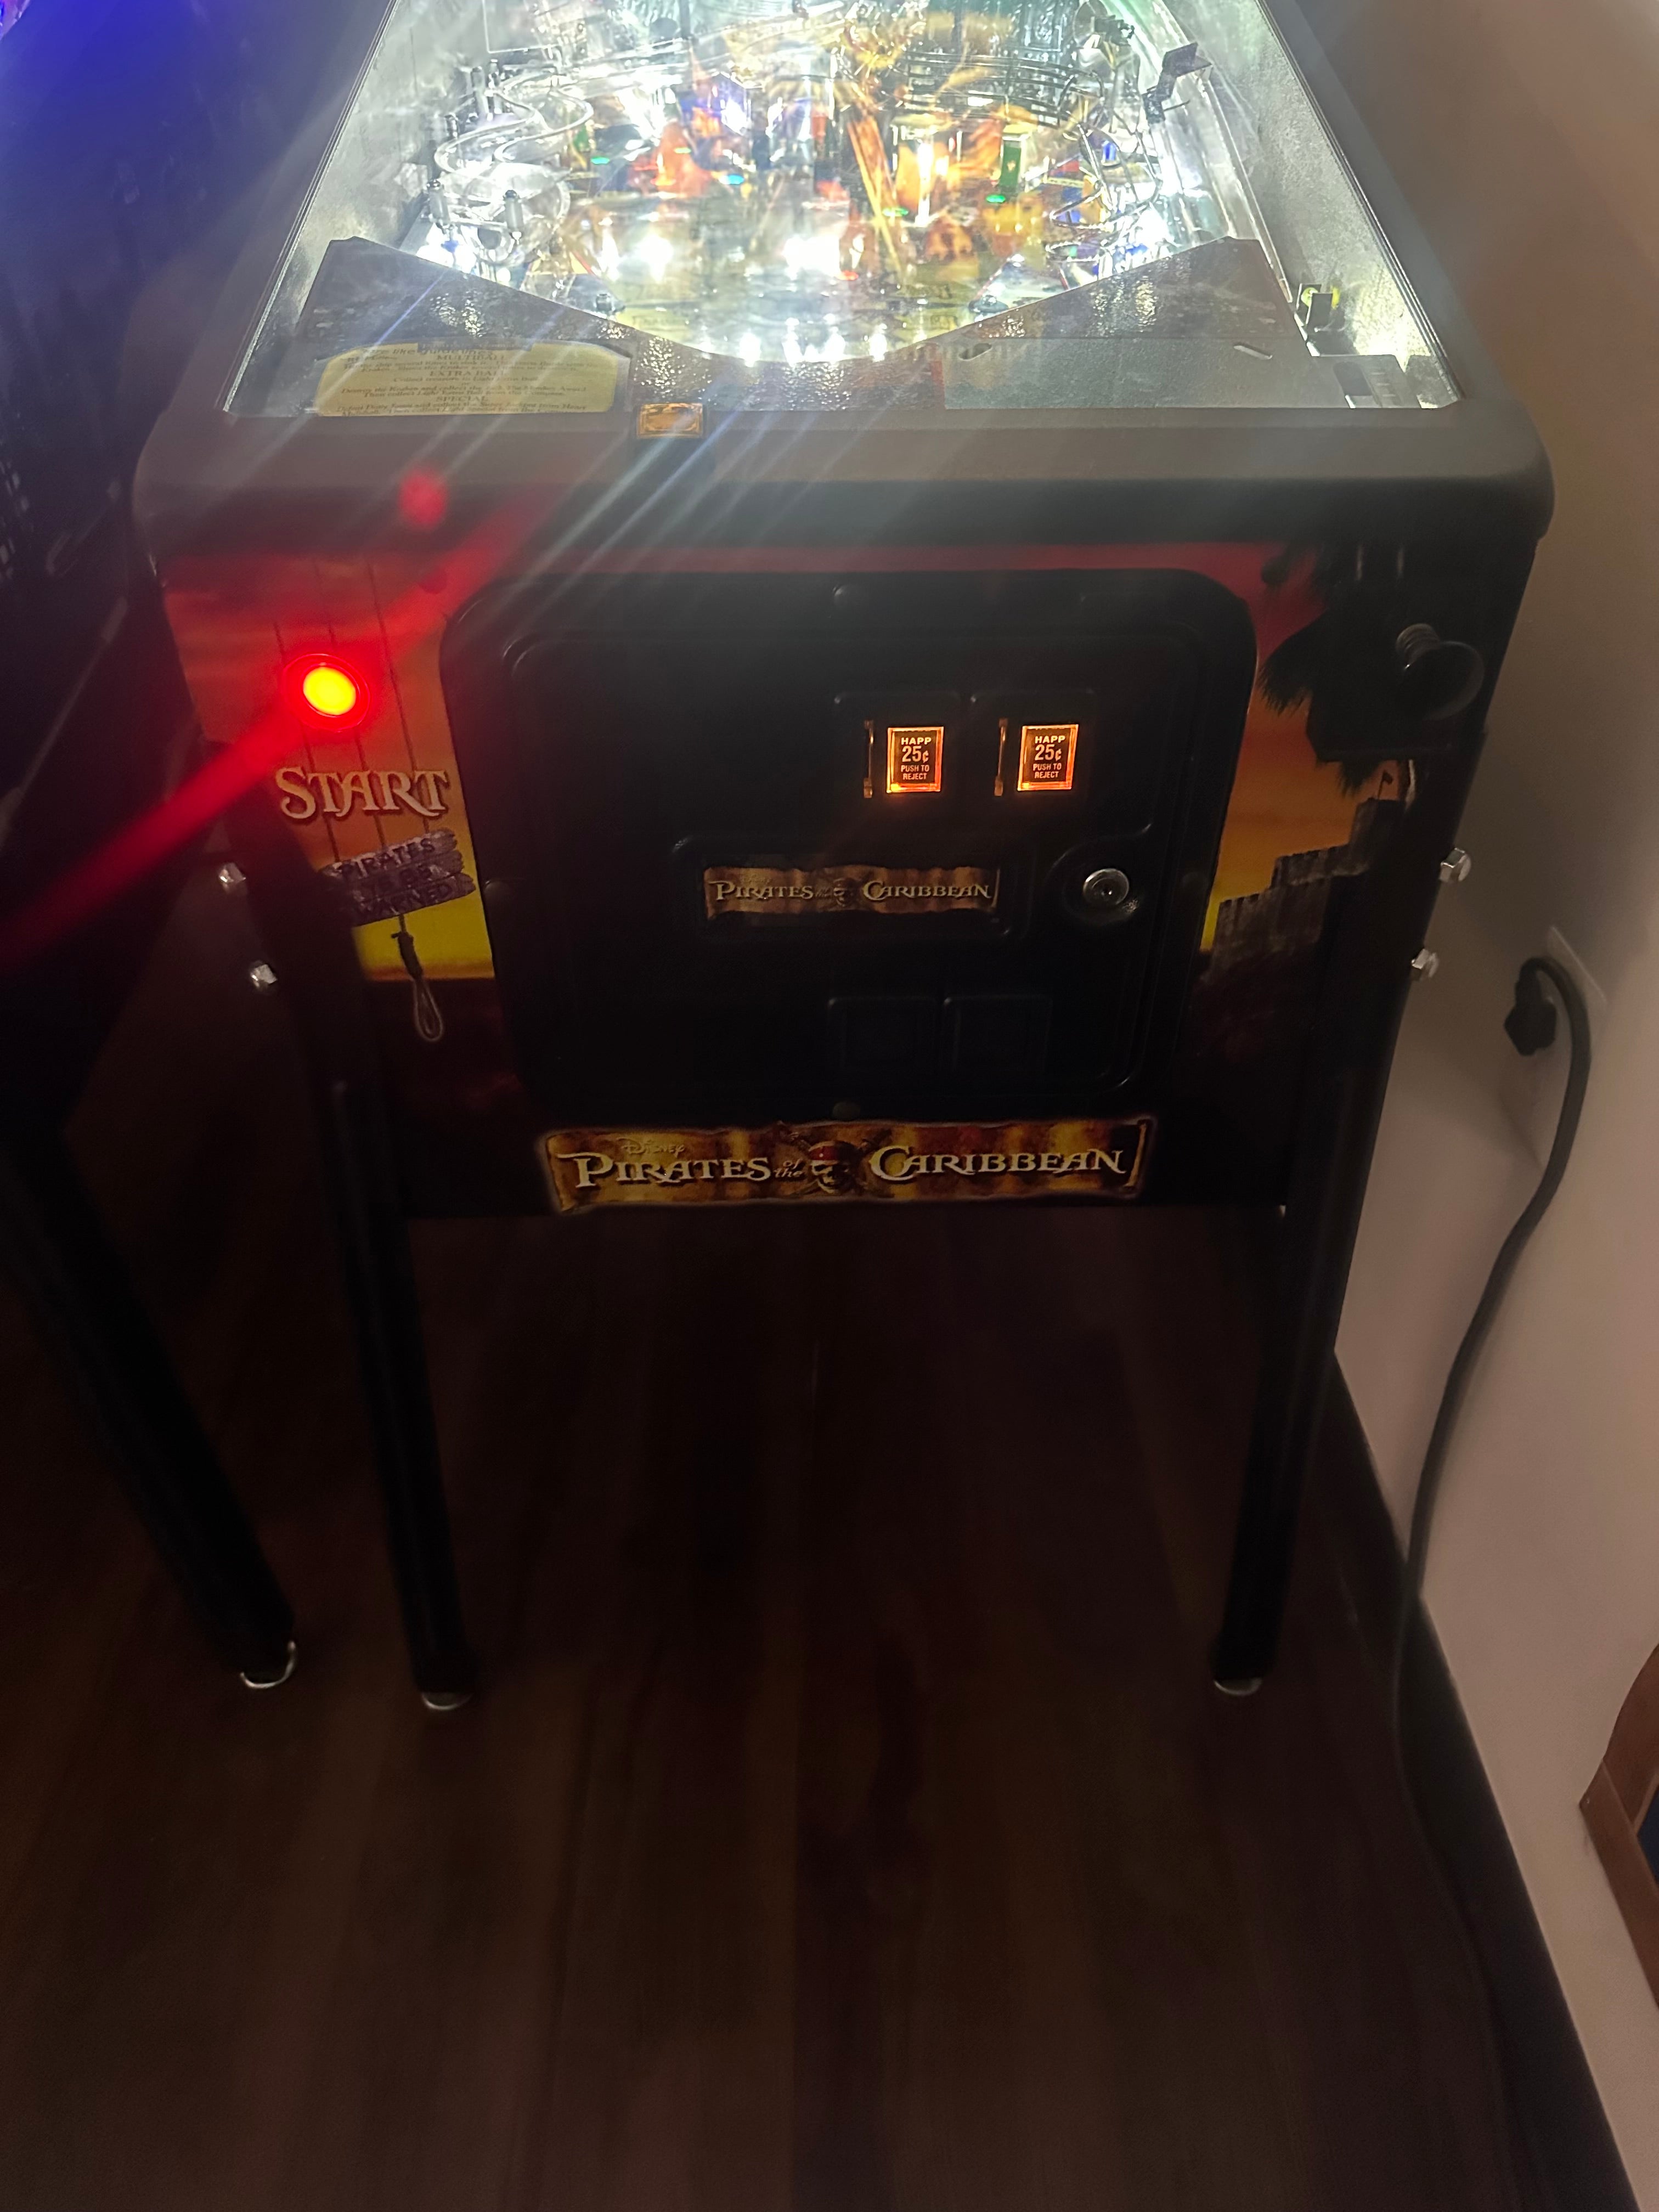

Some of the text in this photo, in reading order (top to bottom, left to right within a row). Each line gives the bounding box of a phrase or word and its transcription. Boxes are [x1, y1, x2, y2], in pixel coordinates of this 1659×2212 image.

[901, 737, 932, 745] HAPP
[1035, 735, 1065, 744] HAPP
[902, 746, 929, 763] 25¢
[1035, 744, 1062, 761] 25¢
[1032, 763, 1052, 771] PUSH
[275, 766, 450, 820] START
[709, 880, 814, 901] PIRATES
[863, 880, 992, 901] CARIBBEAN
[556, 1152, 771, 1188] PIRATES
[774, 1166, 803, 1179] the
[868, 1144, 1127, 1182] CARIBBEAN
